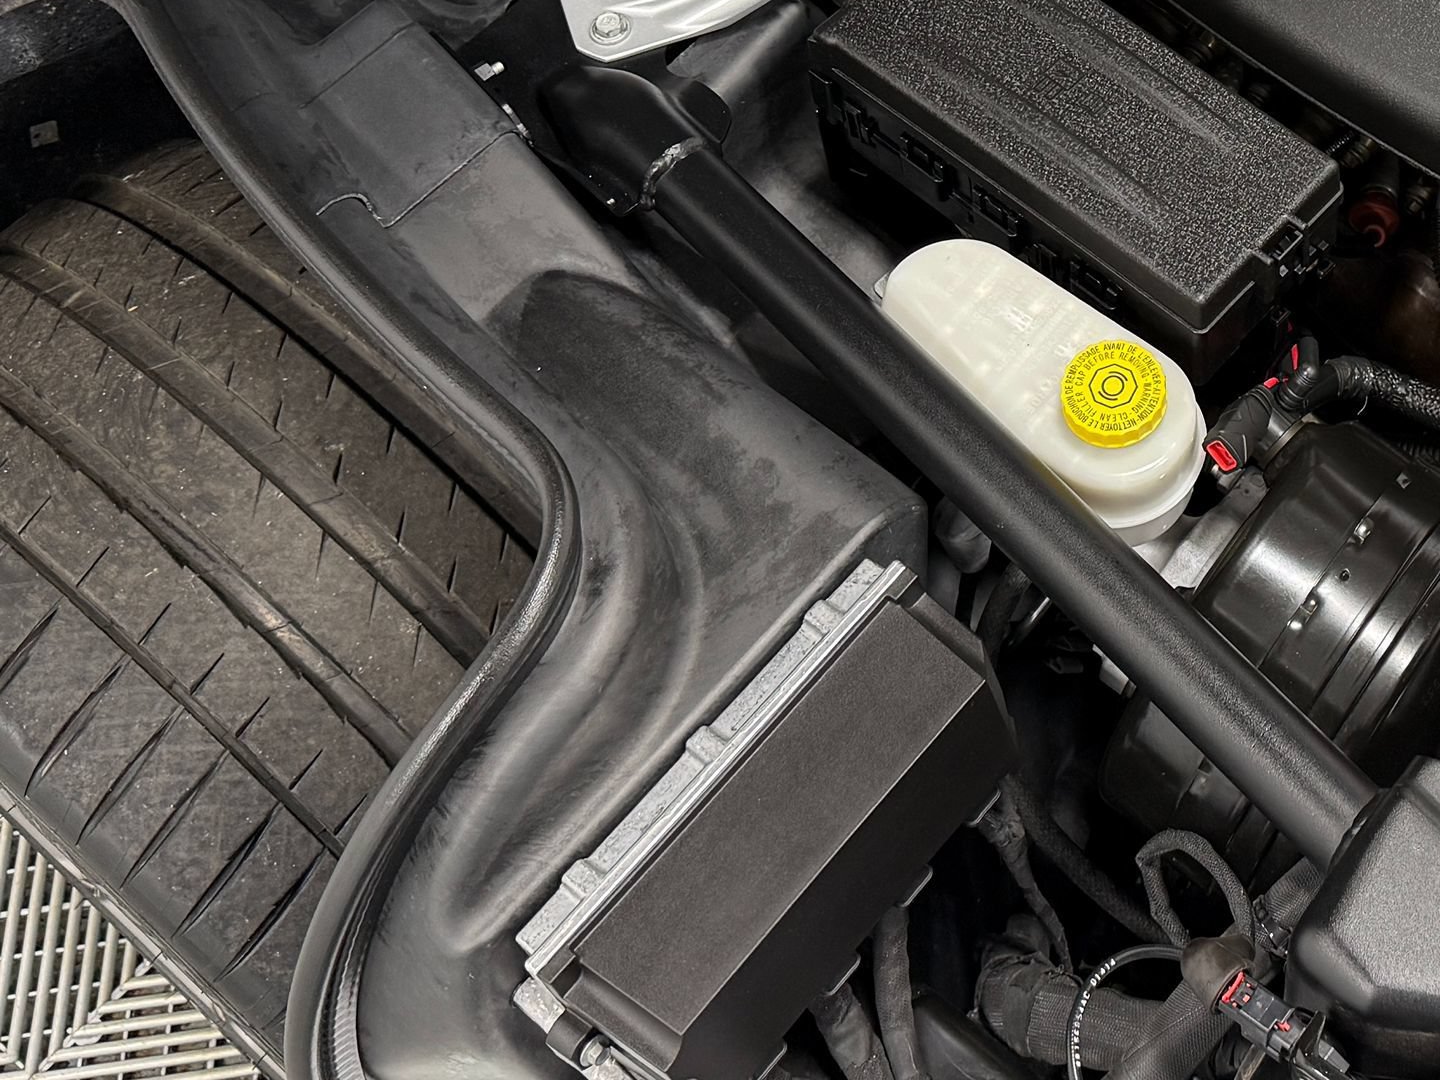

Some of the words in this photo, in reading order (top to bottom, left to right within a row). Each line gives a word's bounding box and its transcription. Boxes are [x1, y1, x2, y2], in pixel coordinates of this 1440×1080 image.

[1103, 342, 1125, 351] AVANT
[1128, 344, 1137, 354] DE
[1065, 346, 1100, 383] REMPLISSAGE
[1084, 351, 1115, 370] BEFORE
[1119, 352, 1149, 378] REMOVING
[1075, 370, 1086, 387] CAP
[1066, 395, 1089, 424] BOUCHON
[1075, 392, 1097, 417] FILLER
[1099, 411, 1128, 422] CLEAN
